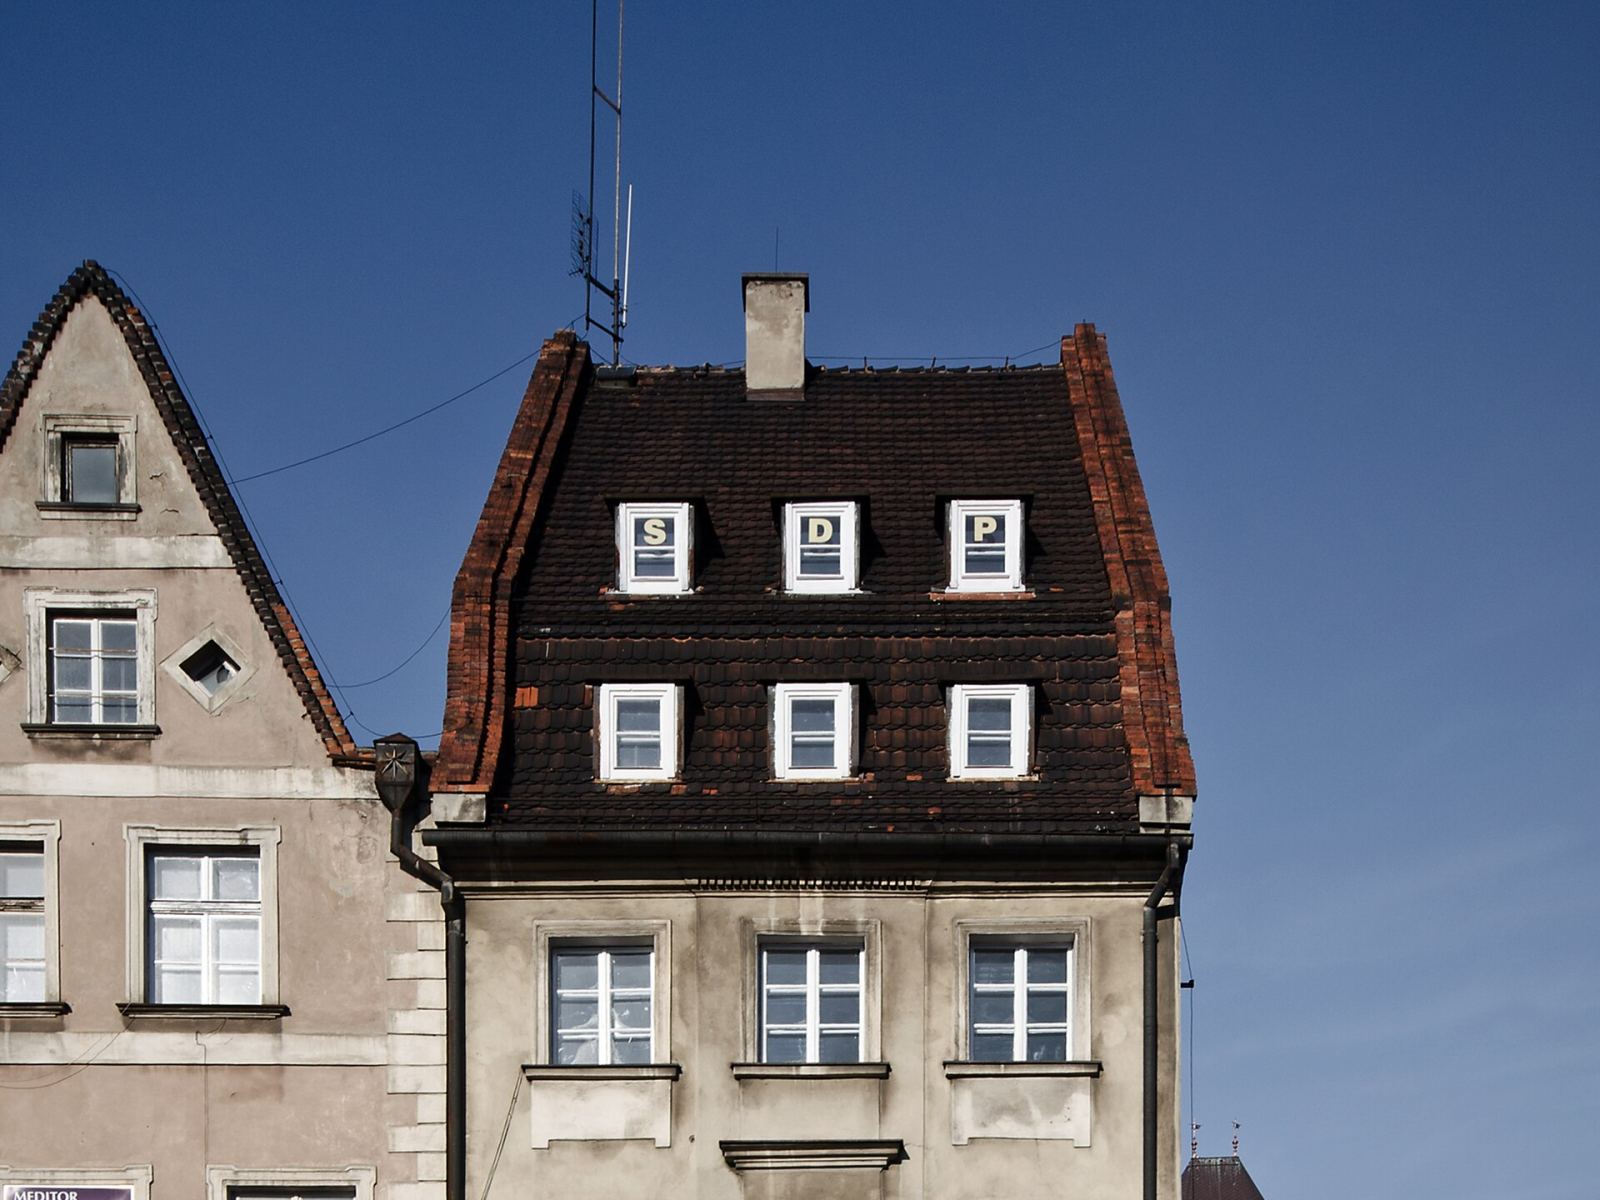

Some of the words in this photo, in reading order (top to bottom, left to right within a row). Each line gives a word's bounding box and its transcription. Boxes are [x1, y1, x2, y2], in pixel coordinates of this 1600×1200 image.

[643, 519, 667, 545] S
[808, 518, 832, 544] D
[973, 516, 997, 541] P
